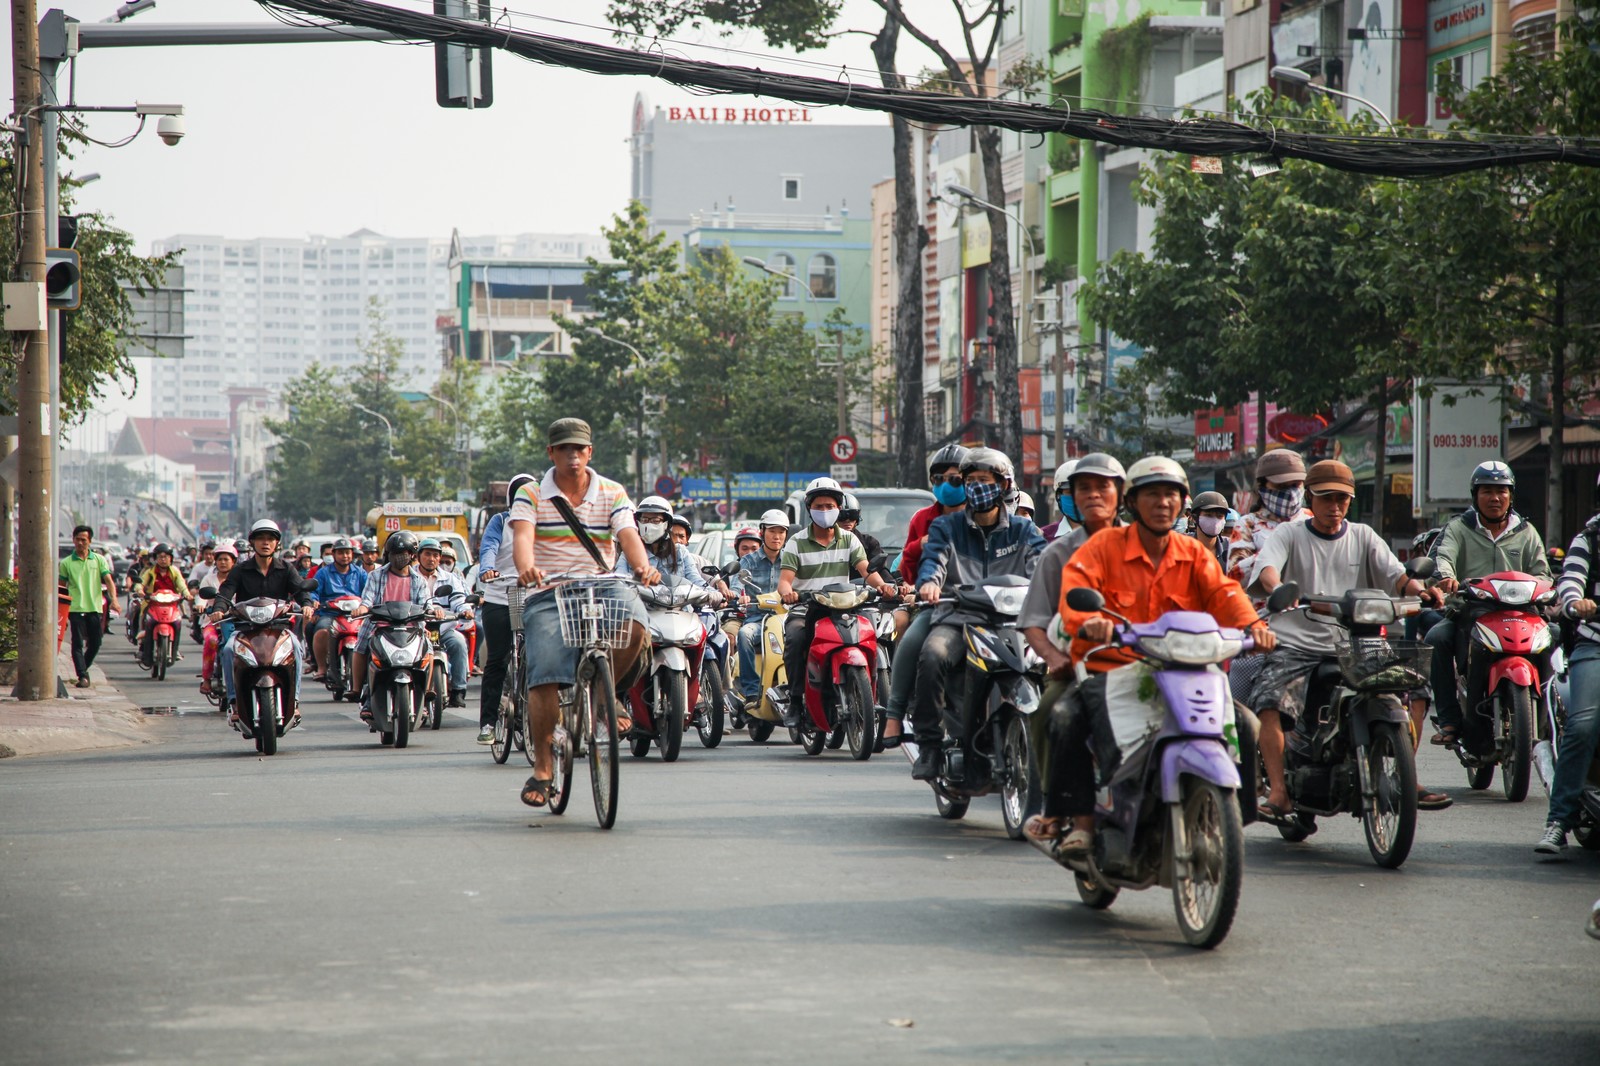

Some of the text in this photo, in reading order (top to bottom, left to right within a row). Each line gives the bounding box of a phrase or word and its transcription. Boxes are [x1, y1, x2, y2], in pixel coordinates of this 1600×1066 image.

[669, 107, 813, 122] BALI B HOTEL
[1433, 434, 1499, 448] 0903.391.936
[386, 518, 399, 530] 46
[442, 519, 452, 530] 46
